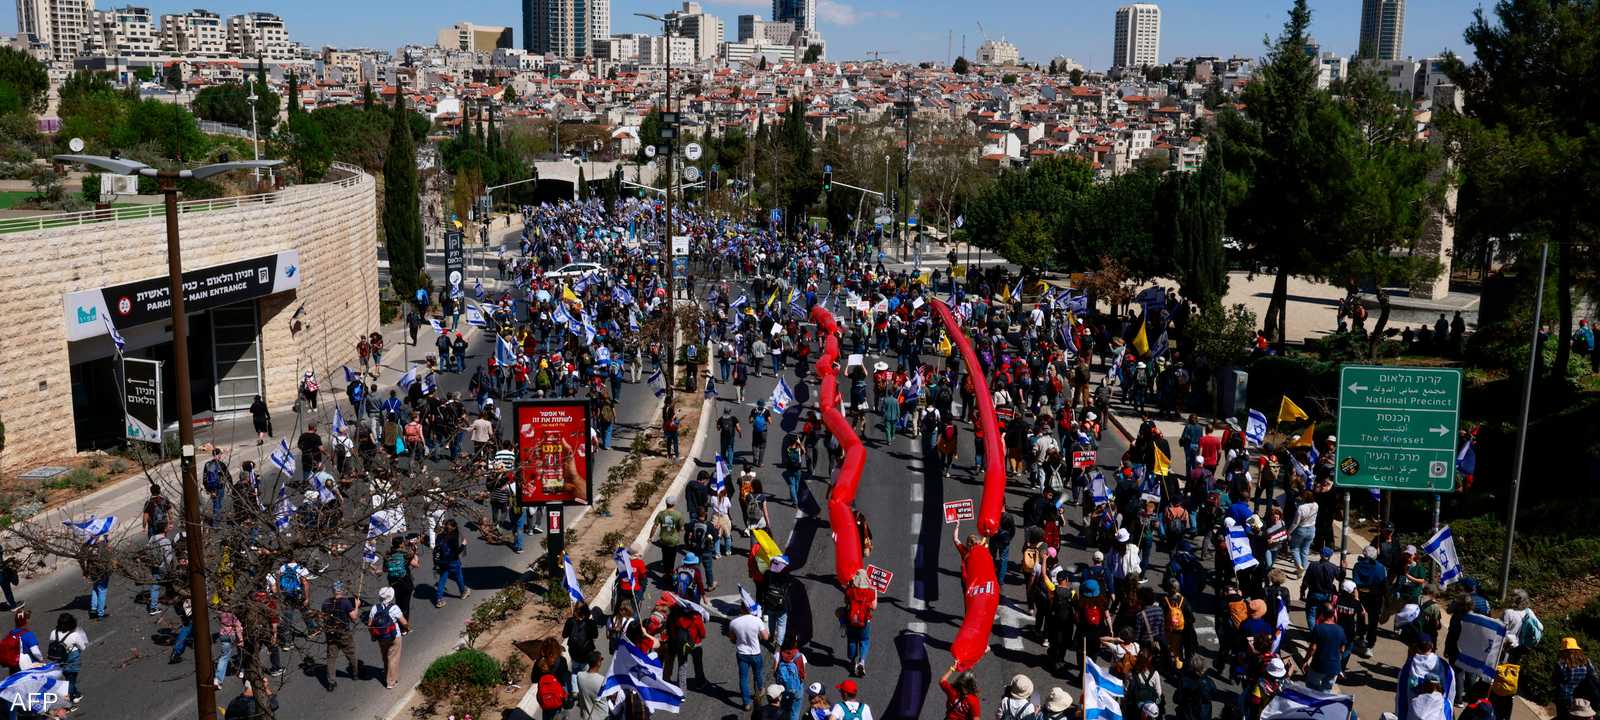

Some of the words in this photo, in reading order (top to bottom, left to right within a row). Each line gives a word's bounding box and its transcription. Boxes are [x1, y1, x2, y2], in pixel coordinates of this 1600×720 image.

[206, 273, 233, 285] הלאום
[234, 269, 253, 280] חניון
[182, 281, 197, 291] כני
[136, 287, 169, 301] ראשית
[146, 298, 170, 310] PARKI
[189, 290, 208, 301] MAIN
[210, 282, 247, 296] ENTRANCE
[1379, 373, 1411, 382] הלאום
[1416, 375, 1441, 384] קרית
[136, 386, 154, 395] חניון
[128, 395, 155, 405] הלאום
[1366, 396, 1406, 404] National
[1410, 396, 1451, 405] Precinct
[1376, 413, 1409, 422] הכנסת
[1382, 434, 1424, 443] Knesset
[1366, 451, 1389, 460] העיר
[1394, 452, 1419, 461] מרכז
[1373, 474, 1408, 482] Center
